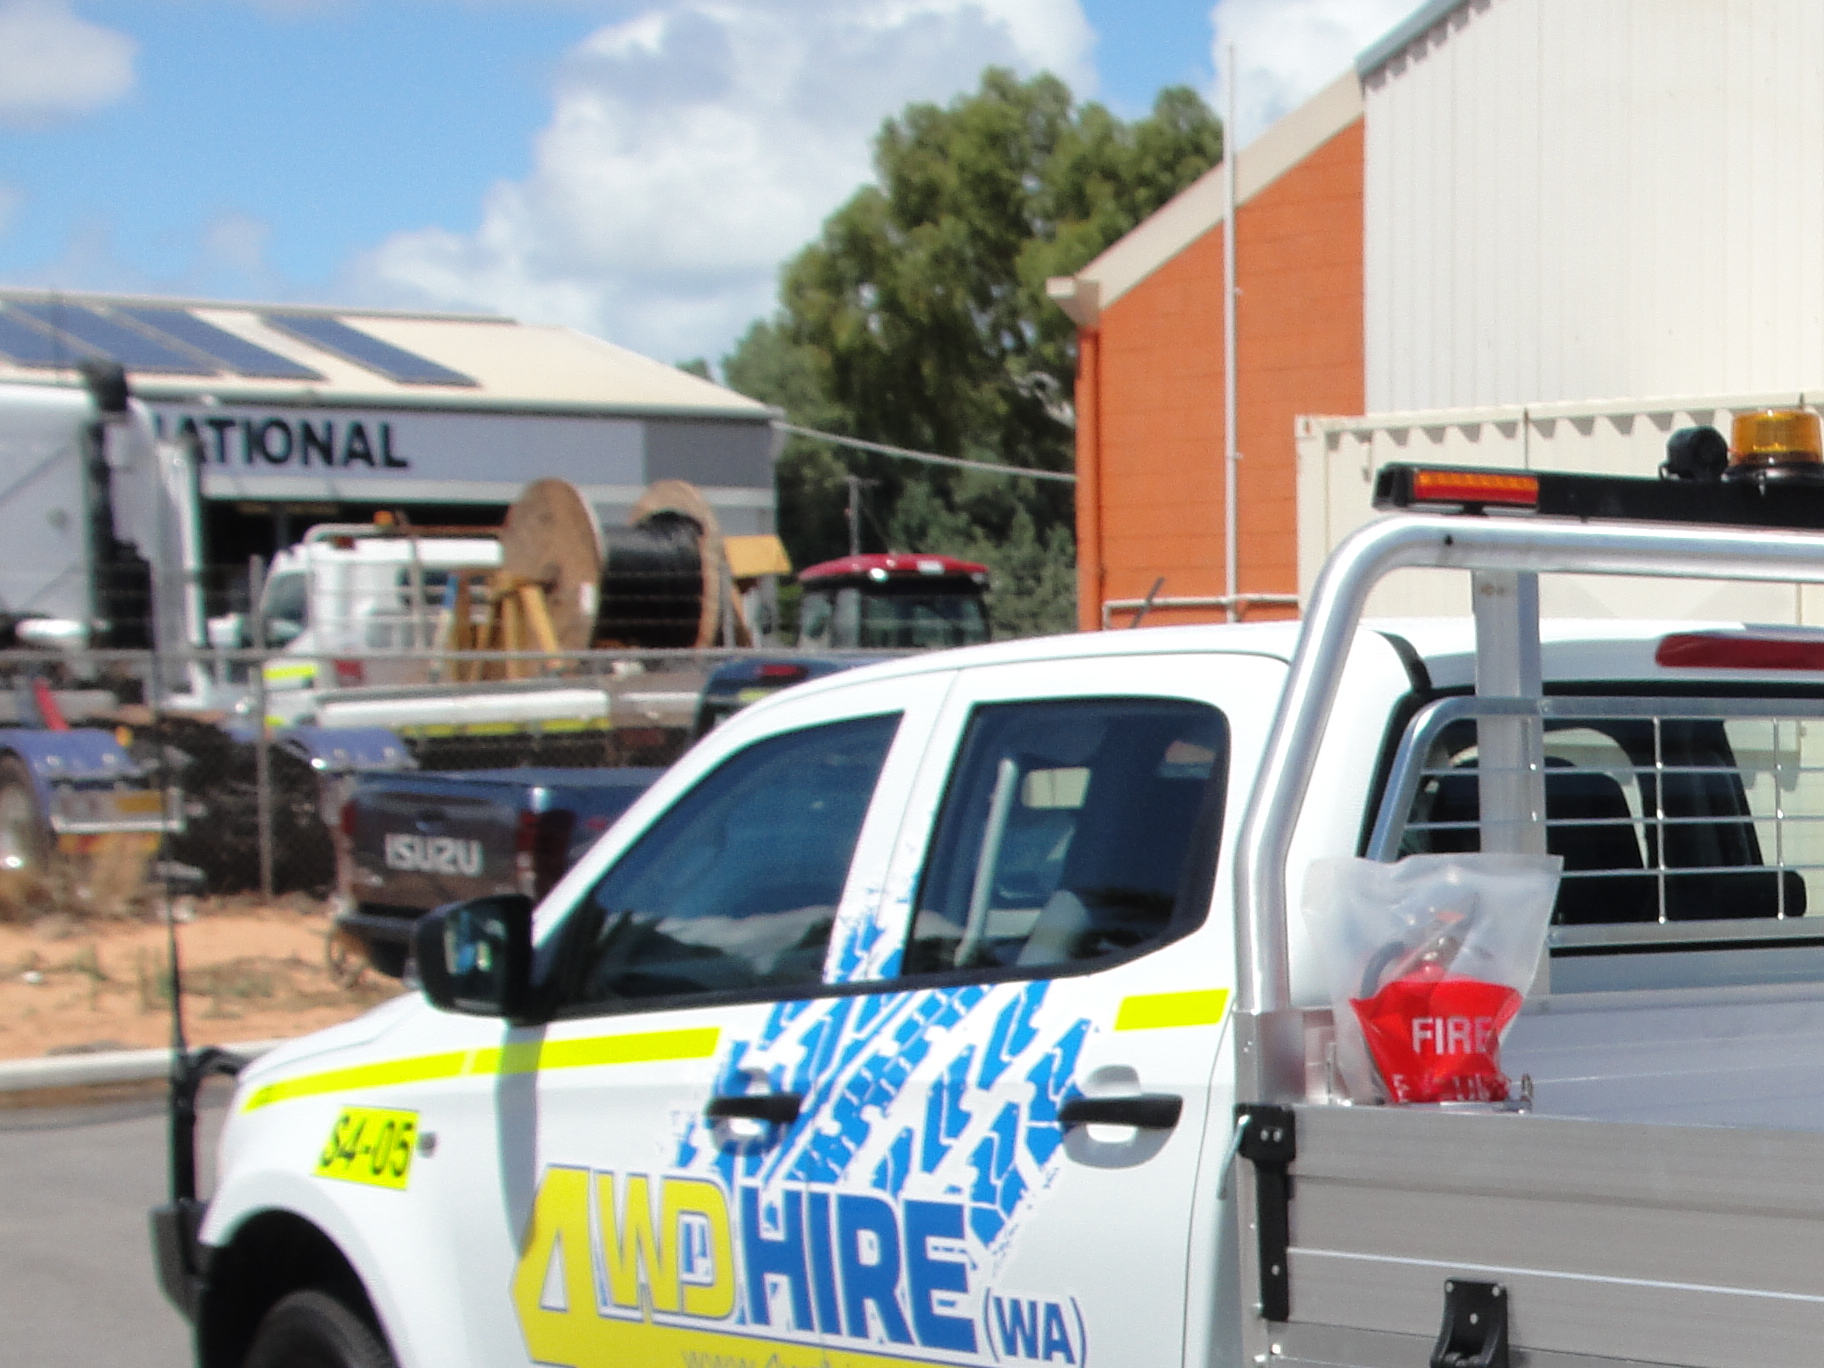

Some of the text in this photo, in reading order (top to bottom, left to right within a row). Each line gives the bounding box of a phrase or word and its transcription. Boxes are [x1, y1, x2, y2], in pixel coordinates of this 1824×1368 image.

[154, 414, 408, 468] ATIONAL
[384, 833, 484, 877] ISUZU
[1411, 1015, 1494, 1055] FIRE
